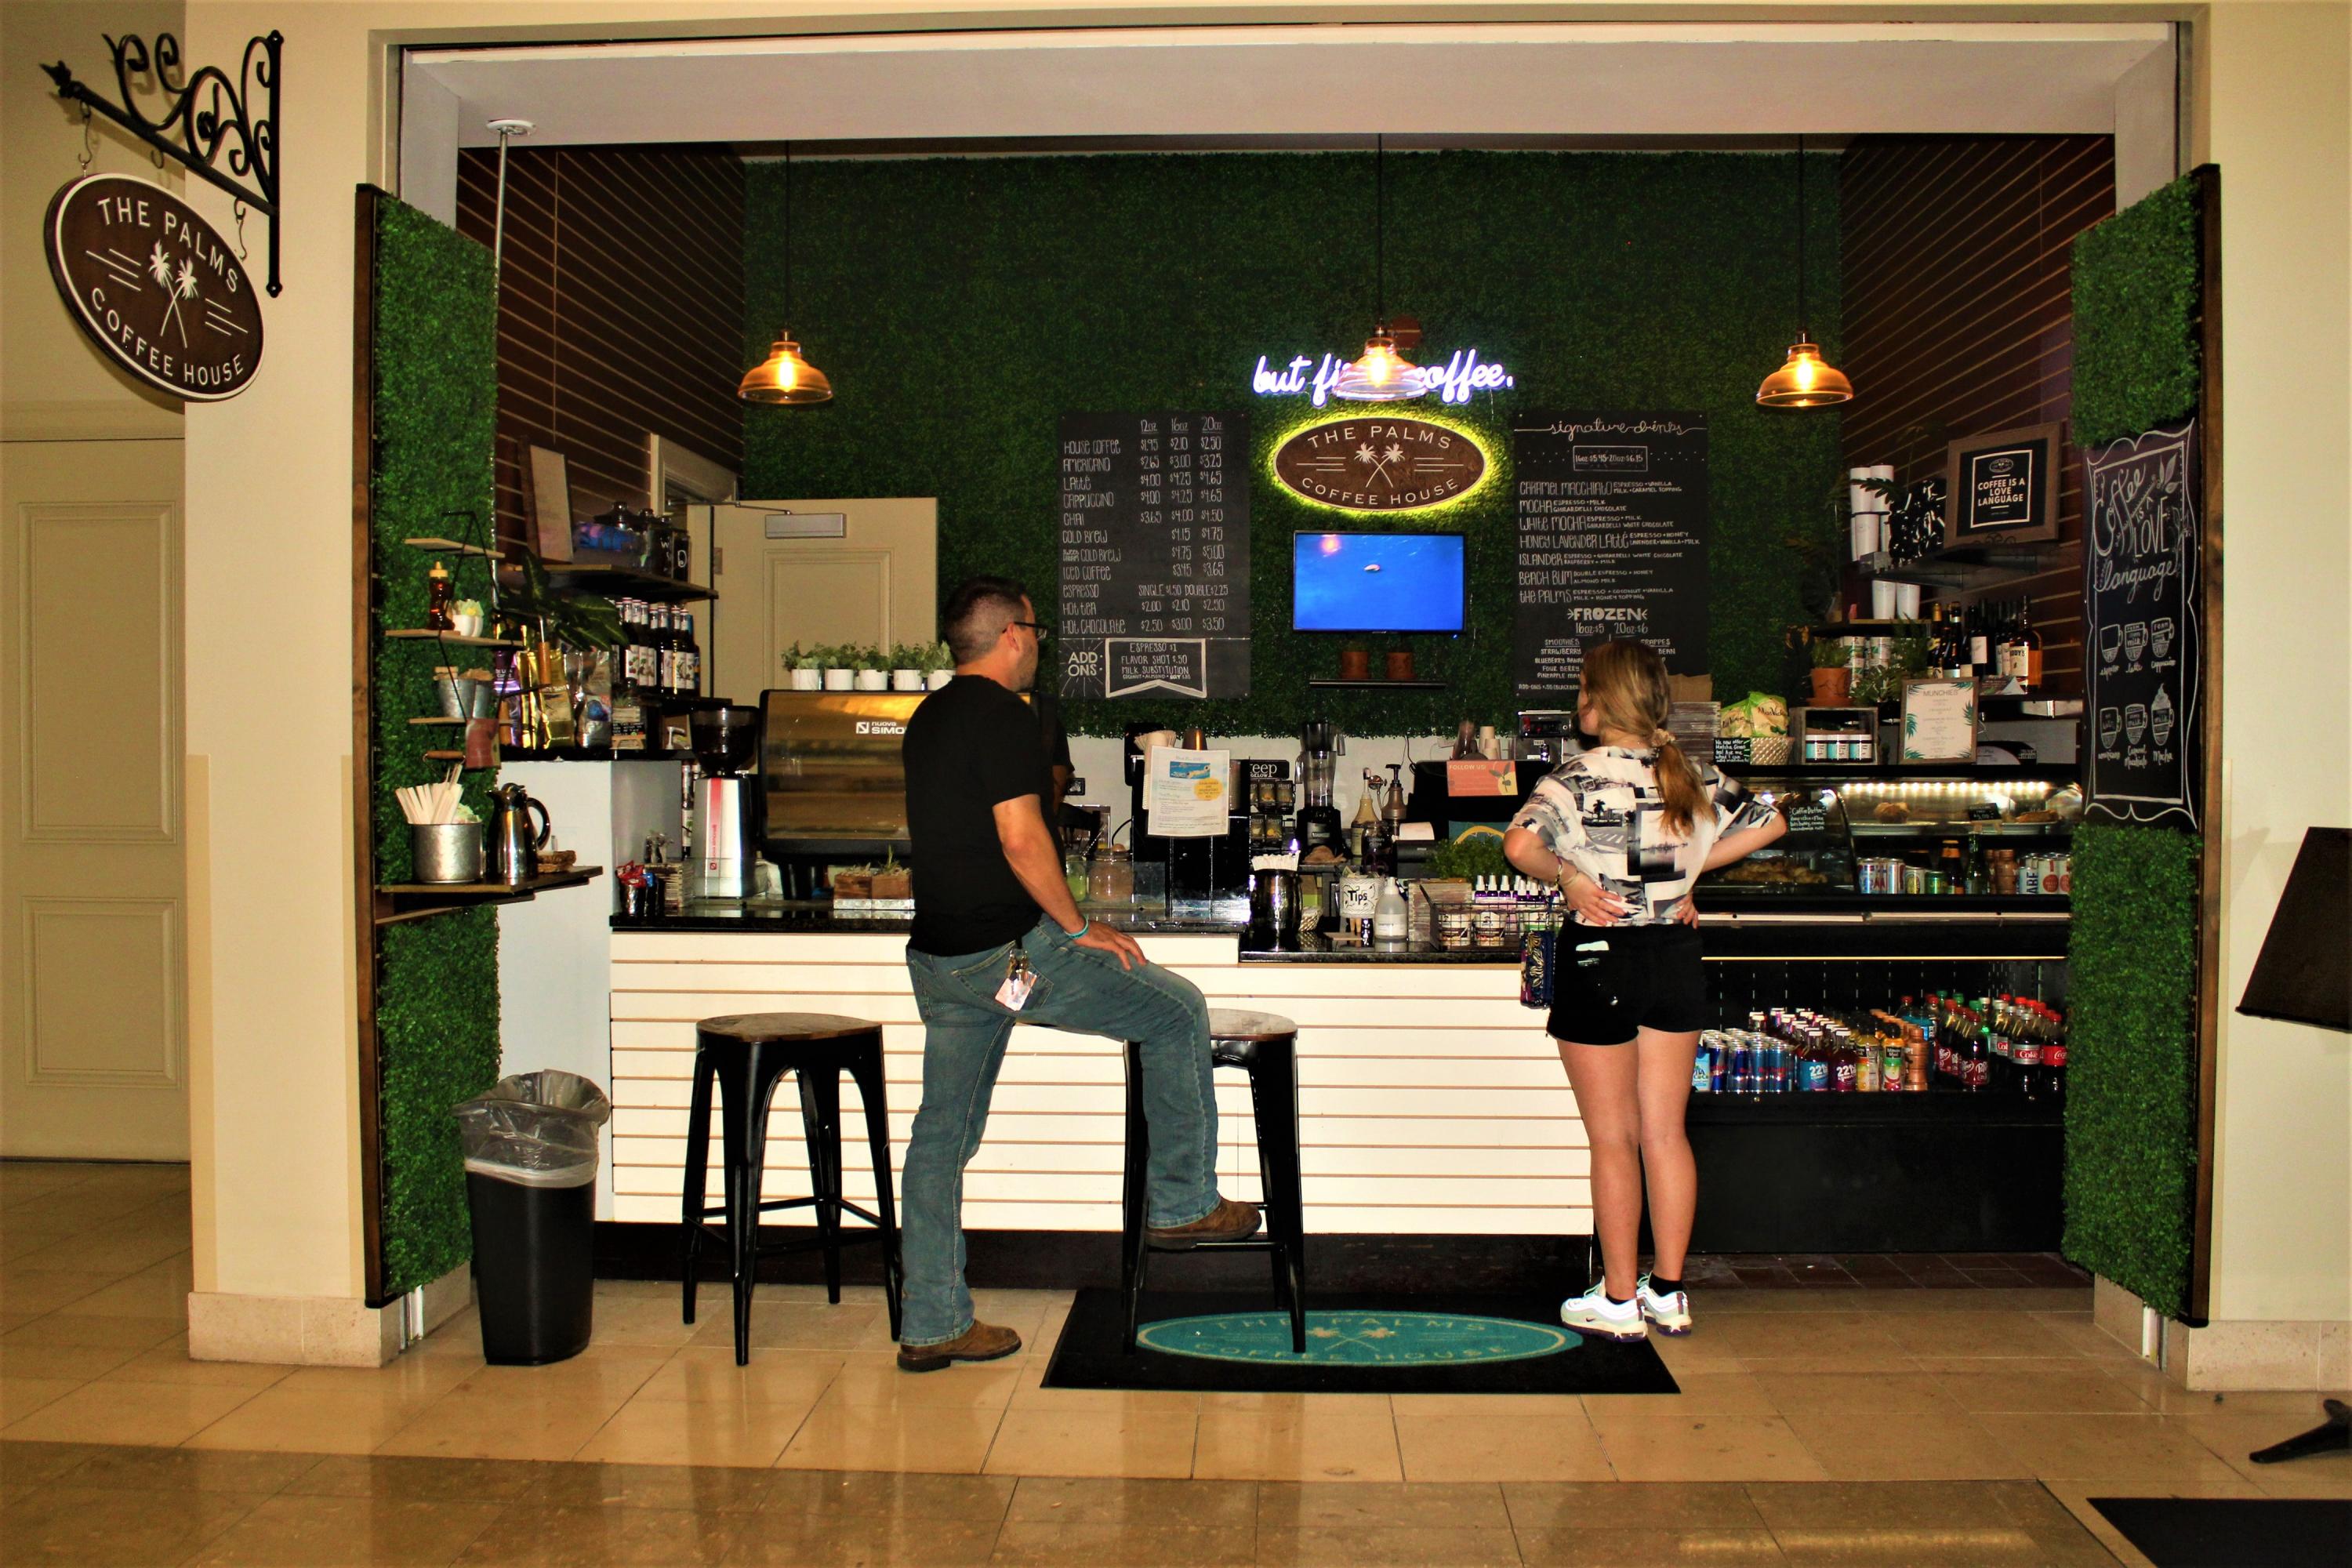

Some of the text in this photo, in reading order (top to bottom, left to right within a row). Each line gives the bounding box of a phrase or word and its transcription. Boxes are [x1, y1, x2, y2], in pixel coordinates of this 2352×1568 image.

[97, 197, 238, 292] THE PALMS
[92, 288, 243, 385] COFFEE HOUSE
[1254, 355, 1312, 393] but
[1141, 416, 1222, 431] 12oz 16oz 20oz
[1141, 439, 1158, 451] $1.95
[1171, 437, 1188, 450] $2.10
[1200, 436, 1221, 450] $2.50
[1308, 426, 1450, 448] THE PALMS
[1141, 456, 1160, 469] $2.65
[1170, 455, 1190, 467] $3.00
[1200, 454, 1221, 468] $3.25
[1141, 474, 1160, 486] $4.00
[1170, 471, 1191, 485] $4.25
[1200, 471, 1221, 485] $4.65
[1978, 479, 2006, 490] COFFEE
[1063, 488, 1222, 509] CAPPUCCINO $4.00 $4.25 $4.65
[1302, 478, 1458, 505] COFFEE HOUSE
[1990, 487, 2012, 496] LOVE
[1519, 499, 1552, 513] MOCHA
[1978, 494, 2024, 506] LANGUAGE
[1064, 509, 1223, 526] CHAI $3.65 $4.00 $4.50
[1552, 516, 1587, 531] MOCHA
[2134, 495, 2169, 557] LOVE
[1062, 530, 1081, 543] COLD
[1171, 528, 1190, 541] $4.15
[1202, 526, 1222, 541] $4.75
[1080, 549, 1097, 562] COLD
[1171, 546, 1192, 560] $4.75
[1203, 544, 1224, 560] $5.00
[1203, 561, 1224, 577] $3.65
[1138, 584, 1164, 596] SINGLE
[1185, 584, 1210, 596] DOUBLE
[1142, 601, 1161, 612] $2.00
[1172, 598, 1189, 612] $2.10
[1203, 598, 1225, 611] $2.50
[1573, 608, 1642, 620] FROZEN
[1142, 619, 1163, 632] $2.50
[1171, 617, 1192, 630] $3.00
[1203, 617, 1224, 631] $3.50
[1130, 642, 1167, 652] ESPRESSO
[1069, 652, 1098, 663] ADD
[1121, 655, 1187, 665] FLAVOR SHOT $.50
[1068, 664, 1097, 676] ONS
[1122, 666, 1189, 674] MILK SUBSTITUTION
[1348, 890, 1367, 906] Tips
